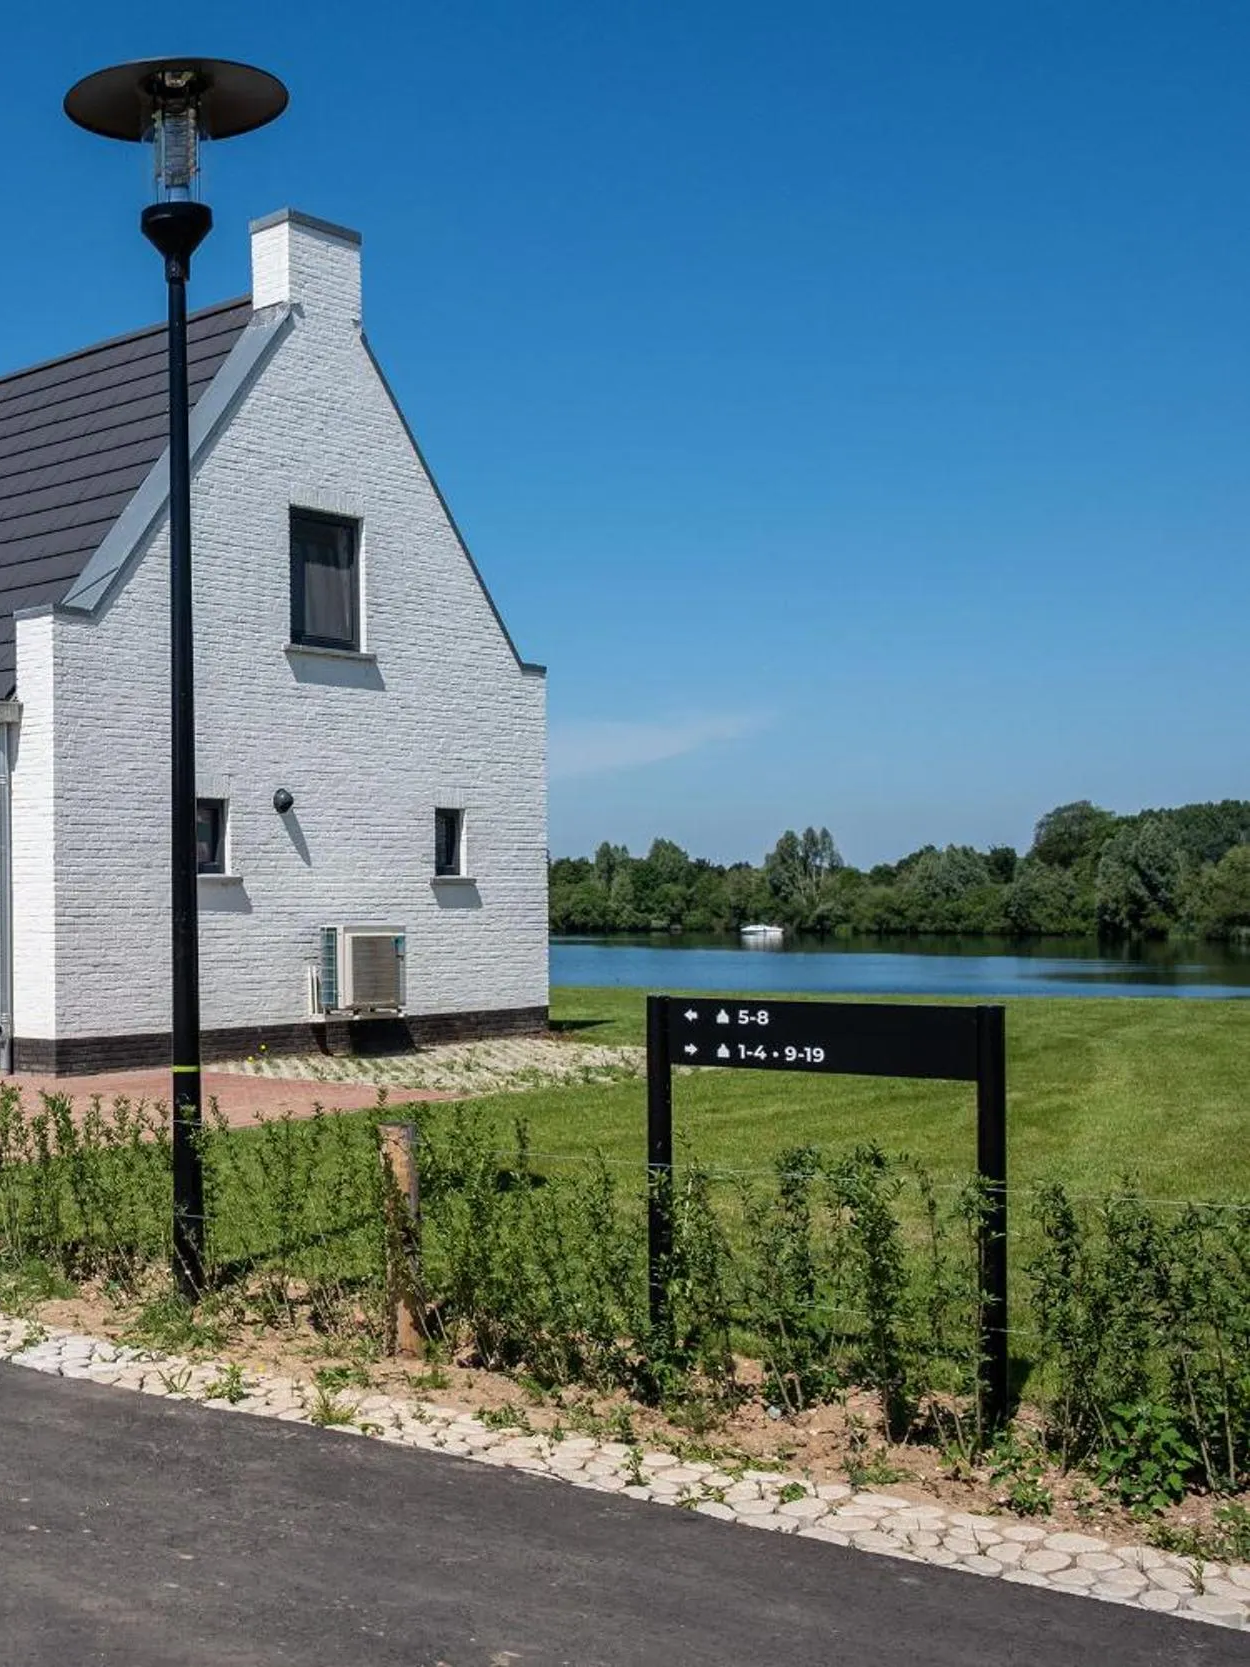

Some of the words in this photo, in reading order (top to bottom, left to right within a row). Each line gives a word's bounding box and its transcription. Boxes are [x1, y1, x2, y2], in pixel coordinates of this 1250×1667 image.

[737, 1009, 770, 1026] 5-8
[737, 1043, 768, 1060] 1-4
[784, 1046, 825, 1063] 9-19
